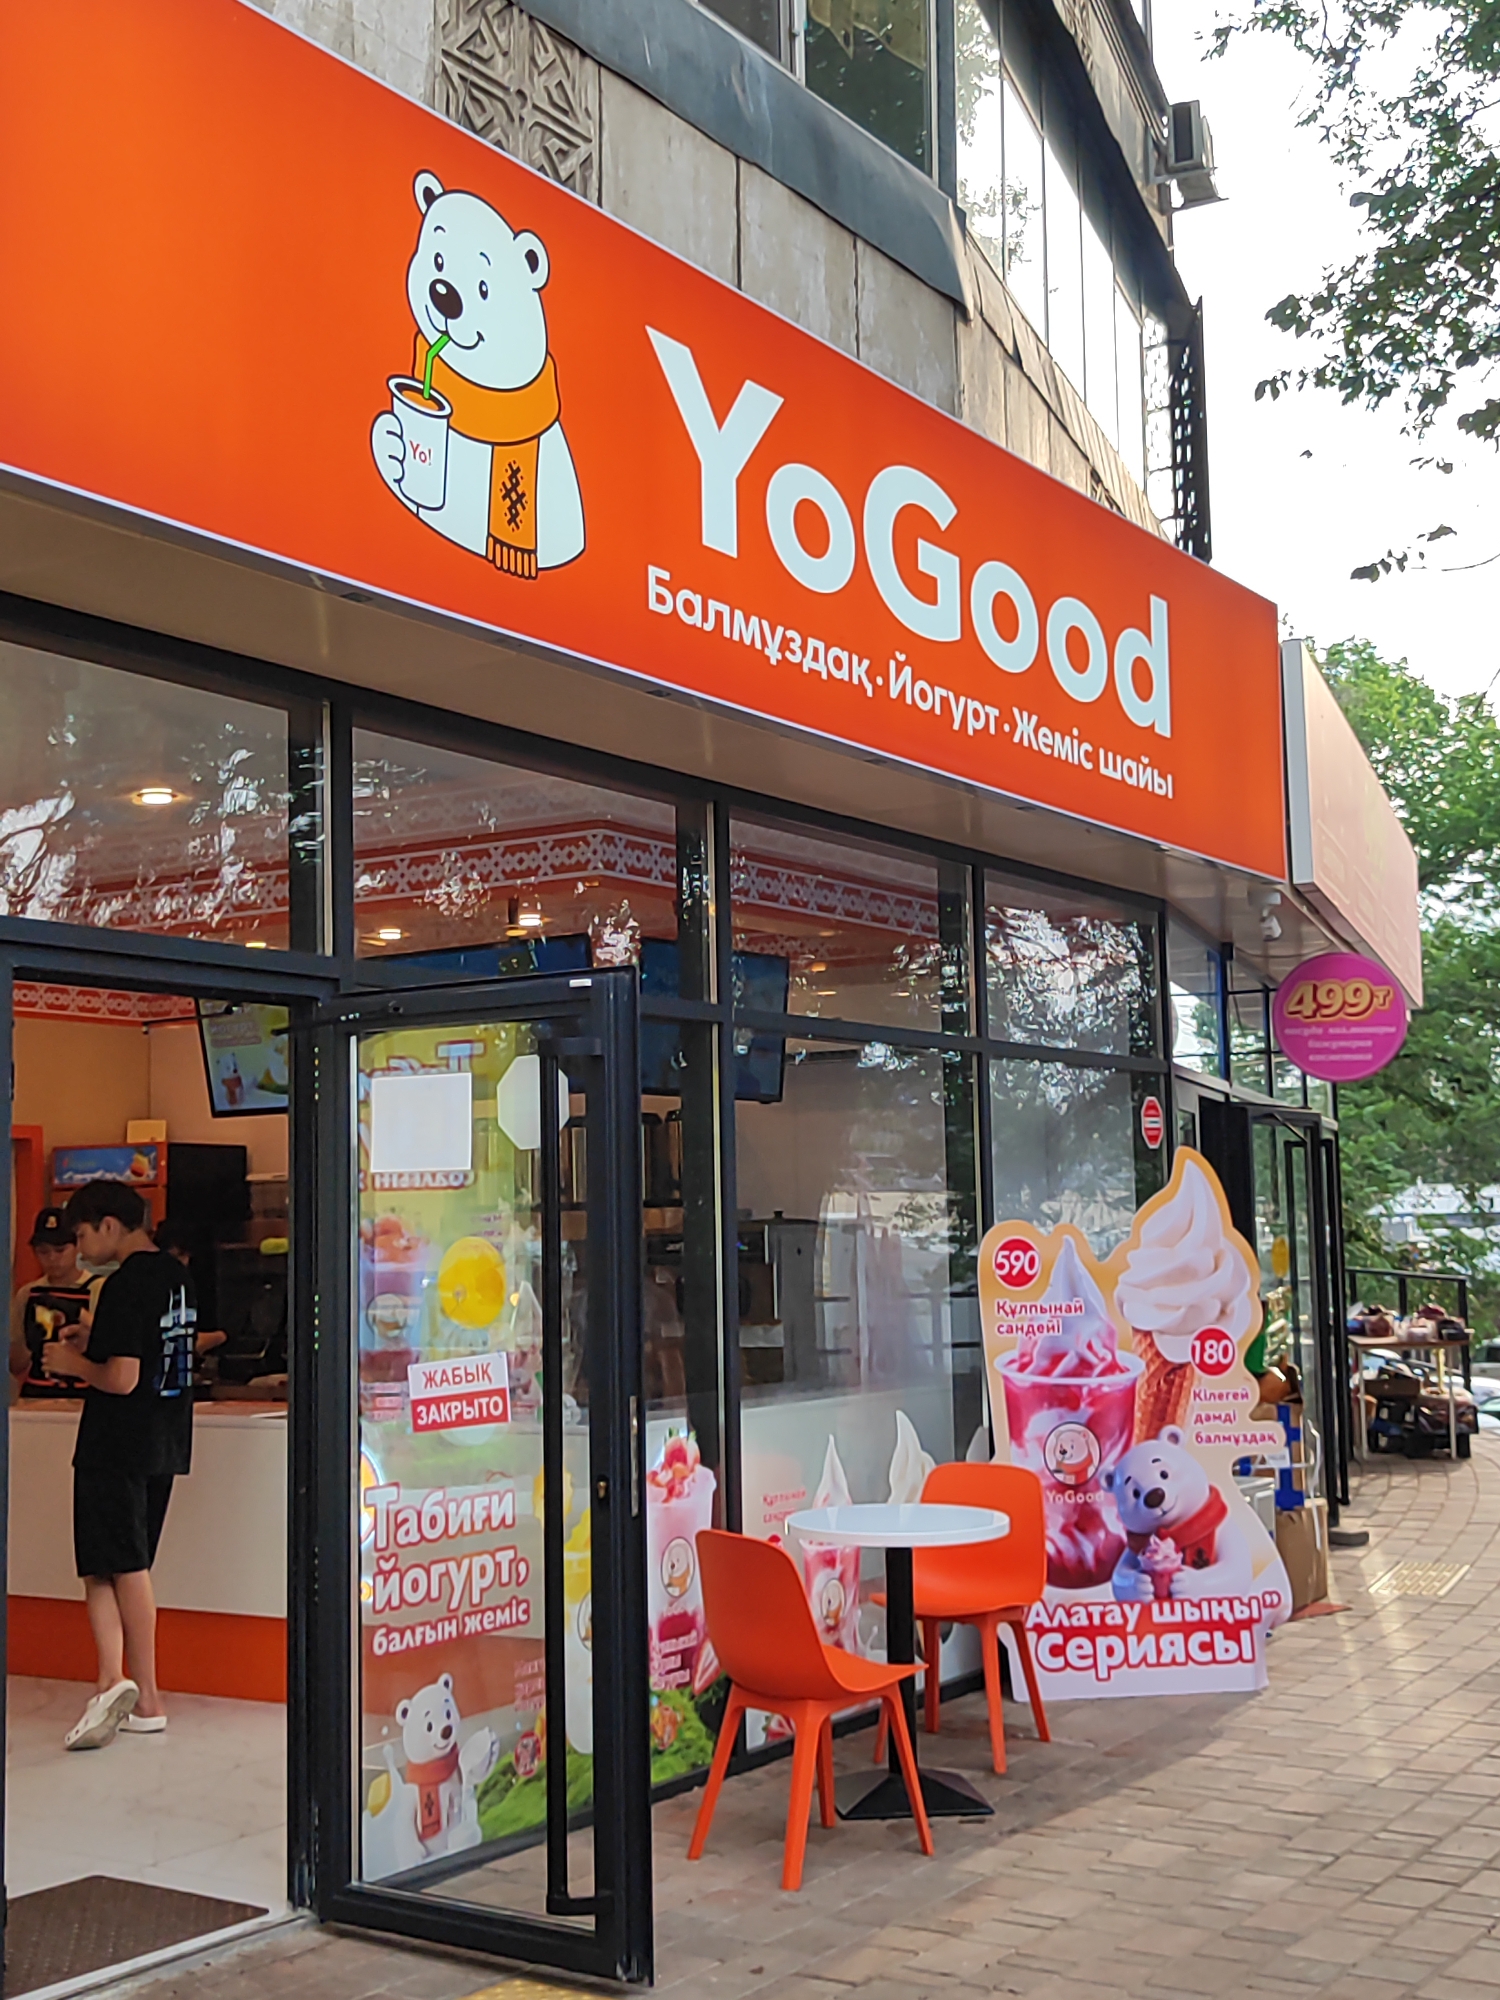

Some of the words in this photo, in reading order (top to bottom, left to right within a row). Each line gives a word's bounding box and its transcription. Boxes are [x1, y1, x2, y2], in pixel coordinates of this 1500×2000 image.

[409, 440, 432, 466] Yo!
[645, 325, 1171, 738] YoGood
[647, 564, 873, 698] Балмұздақ
[889, 651, 999, 736] Йогурт
[1012, 706, 1093, 770] Жеміс
[1099, 748, 1173, 799] шайы
[996, 1250, 1040, 1277] 590
[996, 1299, 1083, 1319] Құлпынай
[996, 1319, 1061, 1337] сандейі
[1193, 1339, 1234, 1365] 180
[422, 1362, 493, 1389] ЖАБЫҚ
[1193, 1387, 1249, 1402] Кілегей
[416, 1396, 504, 1425] ЗАКРЫТО
[364, 1484, 515, 1550] Табиғи
[373, 1547, 530, 1613] йогурт,
[372, 1619, 459, 1657] балғын
[463, 1598, 529, 1636] жеміс
